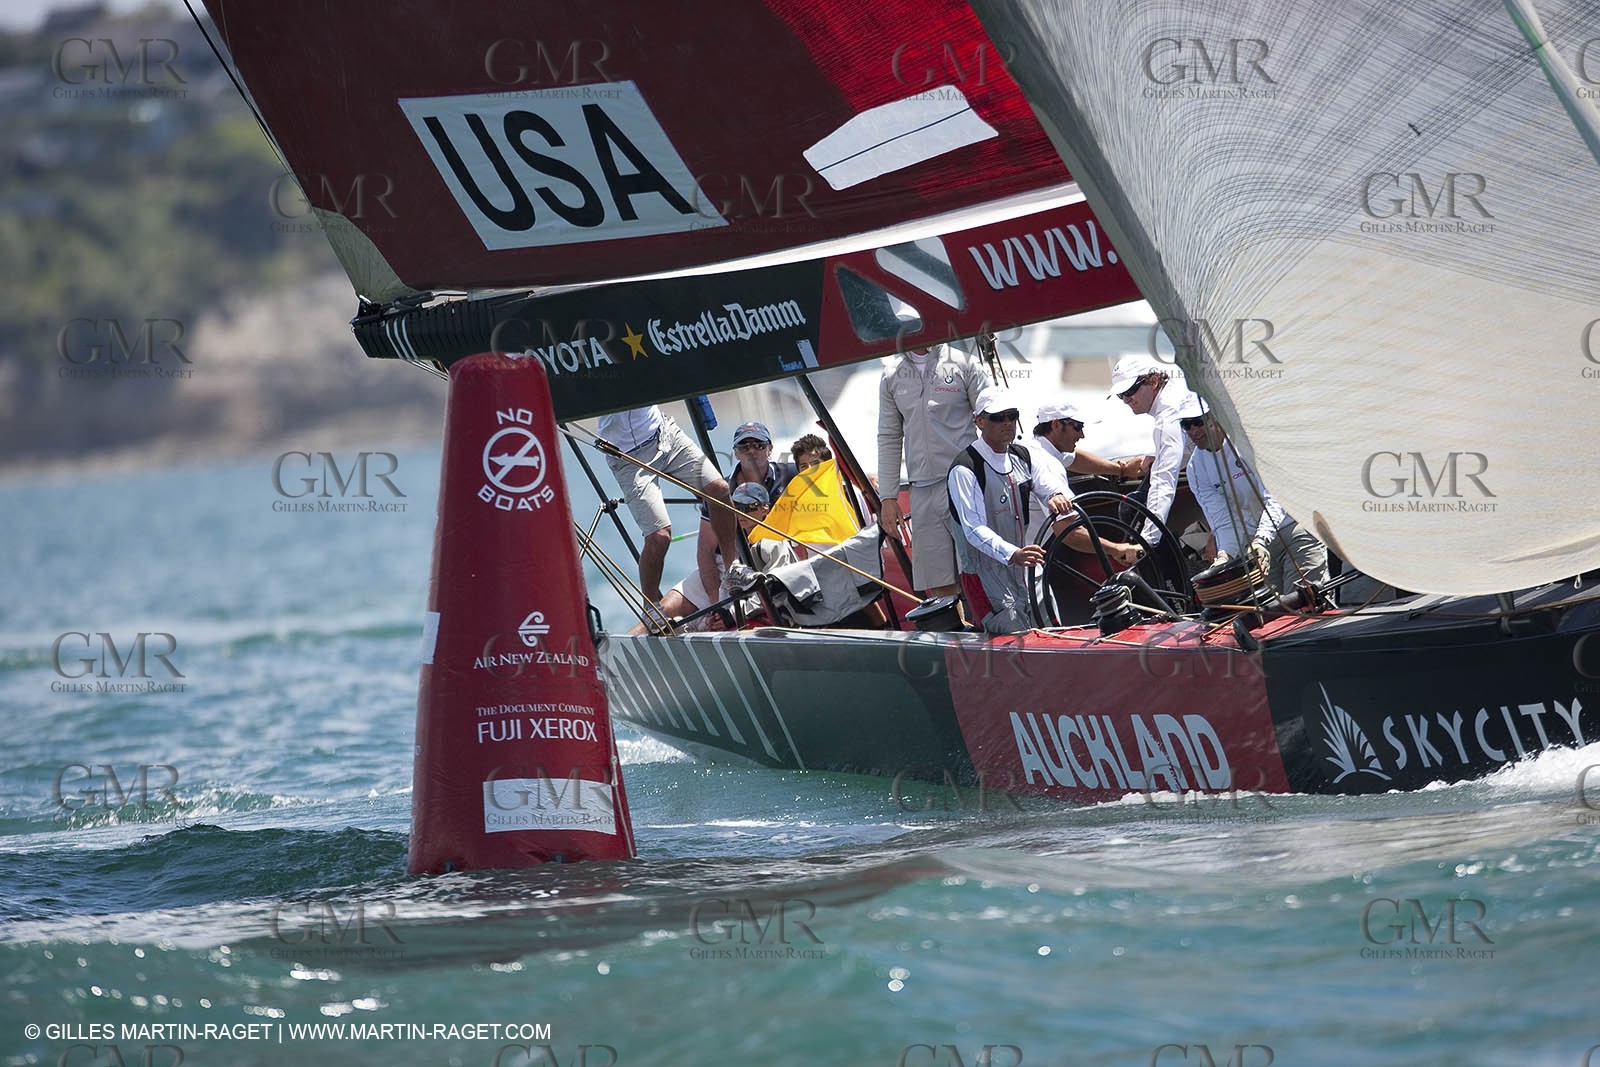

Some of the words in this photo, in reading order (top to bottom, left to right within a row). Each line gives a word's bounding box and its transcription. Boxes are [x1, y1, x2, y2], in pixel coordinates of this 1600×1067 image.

[422, 103, 695, 232] USA
[496, 408, 533, 425] NO
[478, 484, 554, 511] BOATS
[473, 655, 498, 670] AIR
[500, 652, 533, 667] NEW
[536, 651, 589, 667] ZEALAND
[476, 707, 496, 717] THE
[499, 703, 557, 715] DOCUMENT
[558, 703, 594, 716] COMPANY
[477, 719, 522, 744] FUJI
[529, 718, 598, 743] XEROX
[1382, 697, 1585, 770] SKYCITY
[1009, 711, 1231, 792] AUCKLAND
